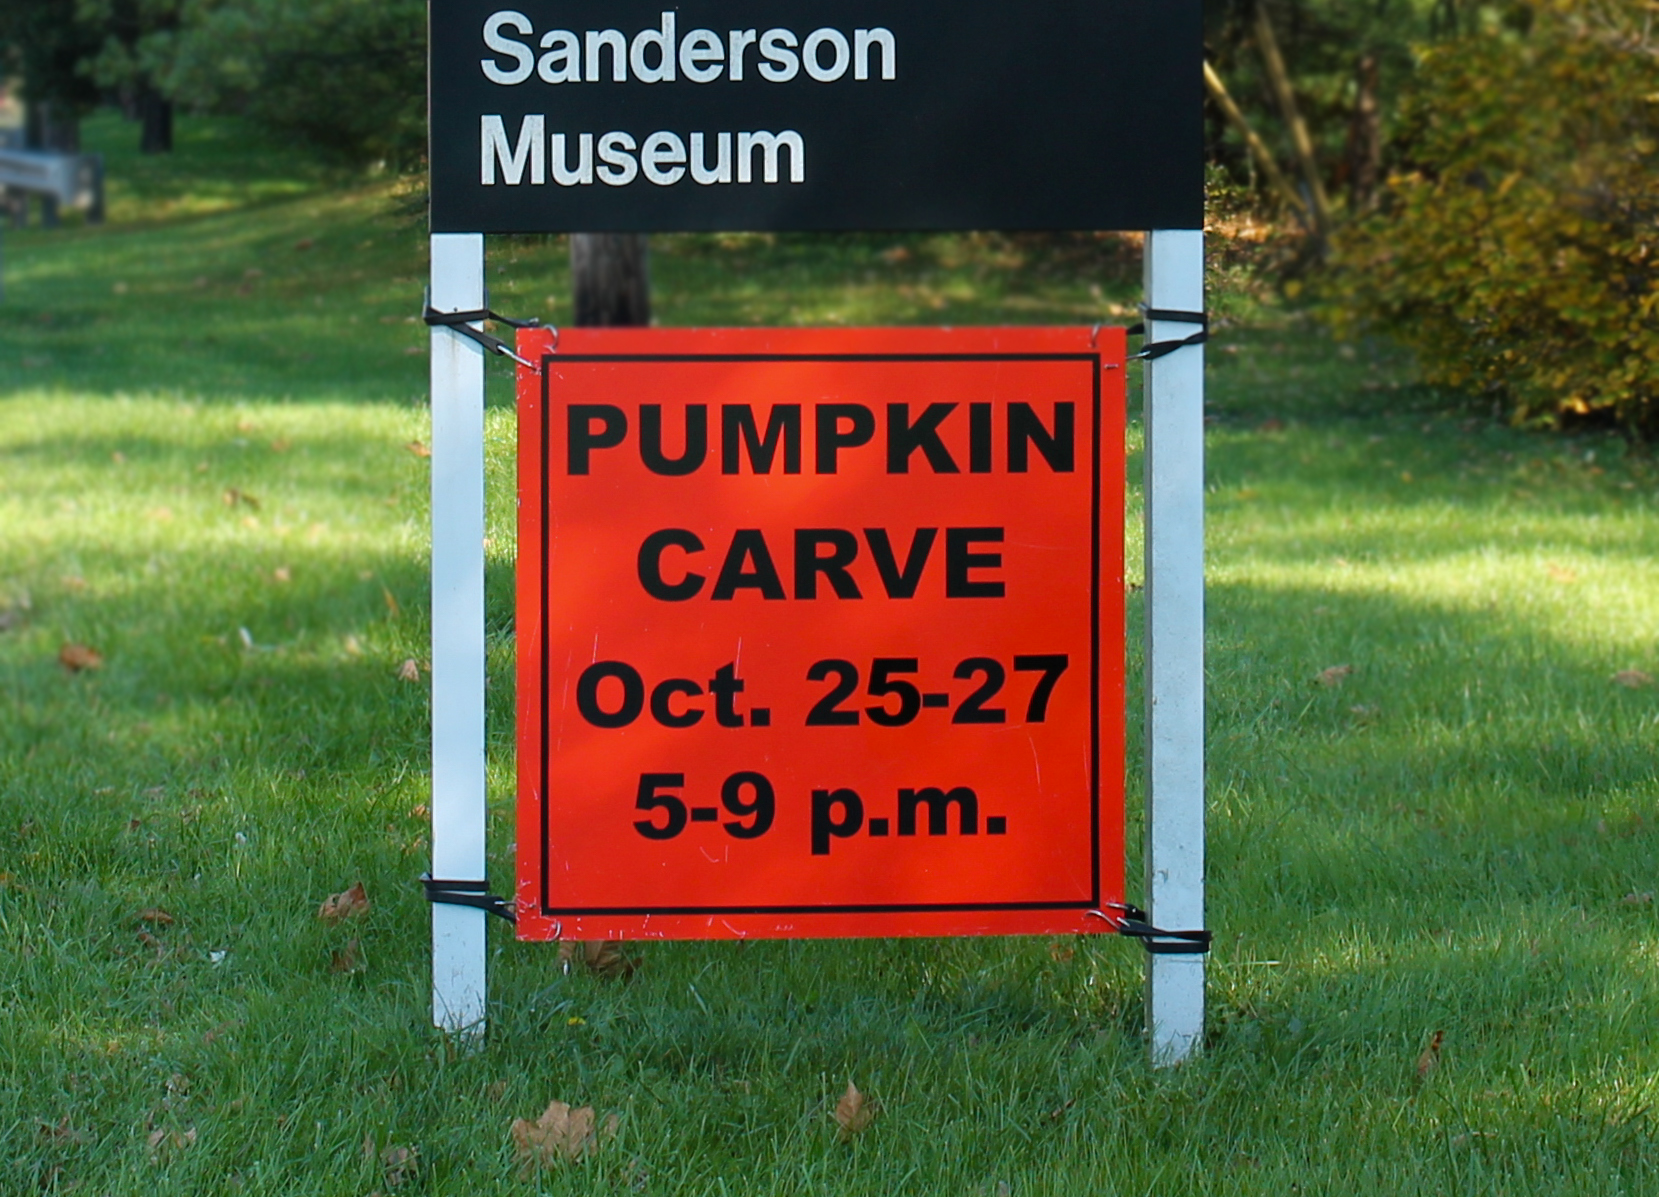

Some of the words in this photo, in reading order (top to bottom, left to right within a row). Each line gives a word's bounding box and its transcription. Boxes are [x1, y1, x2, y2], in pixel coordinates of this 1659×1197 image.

[480, 10, 897, 85] Sanderson
[480, 114, 805, 186] Museum
[566, 401, 1075, 476] PUMPKIN
[637, 526, 1006, 601] CARVE
[576, 660, 771, 729] Oct.
[805, 654, 1069, 727] 25-27
[633, 771, 776, 840] 5-9
[810, 786, 1007, 856] p.m.
